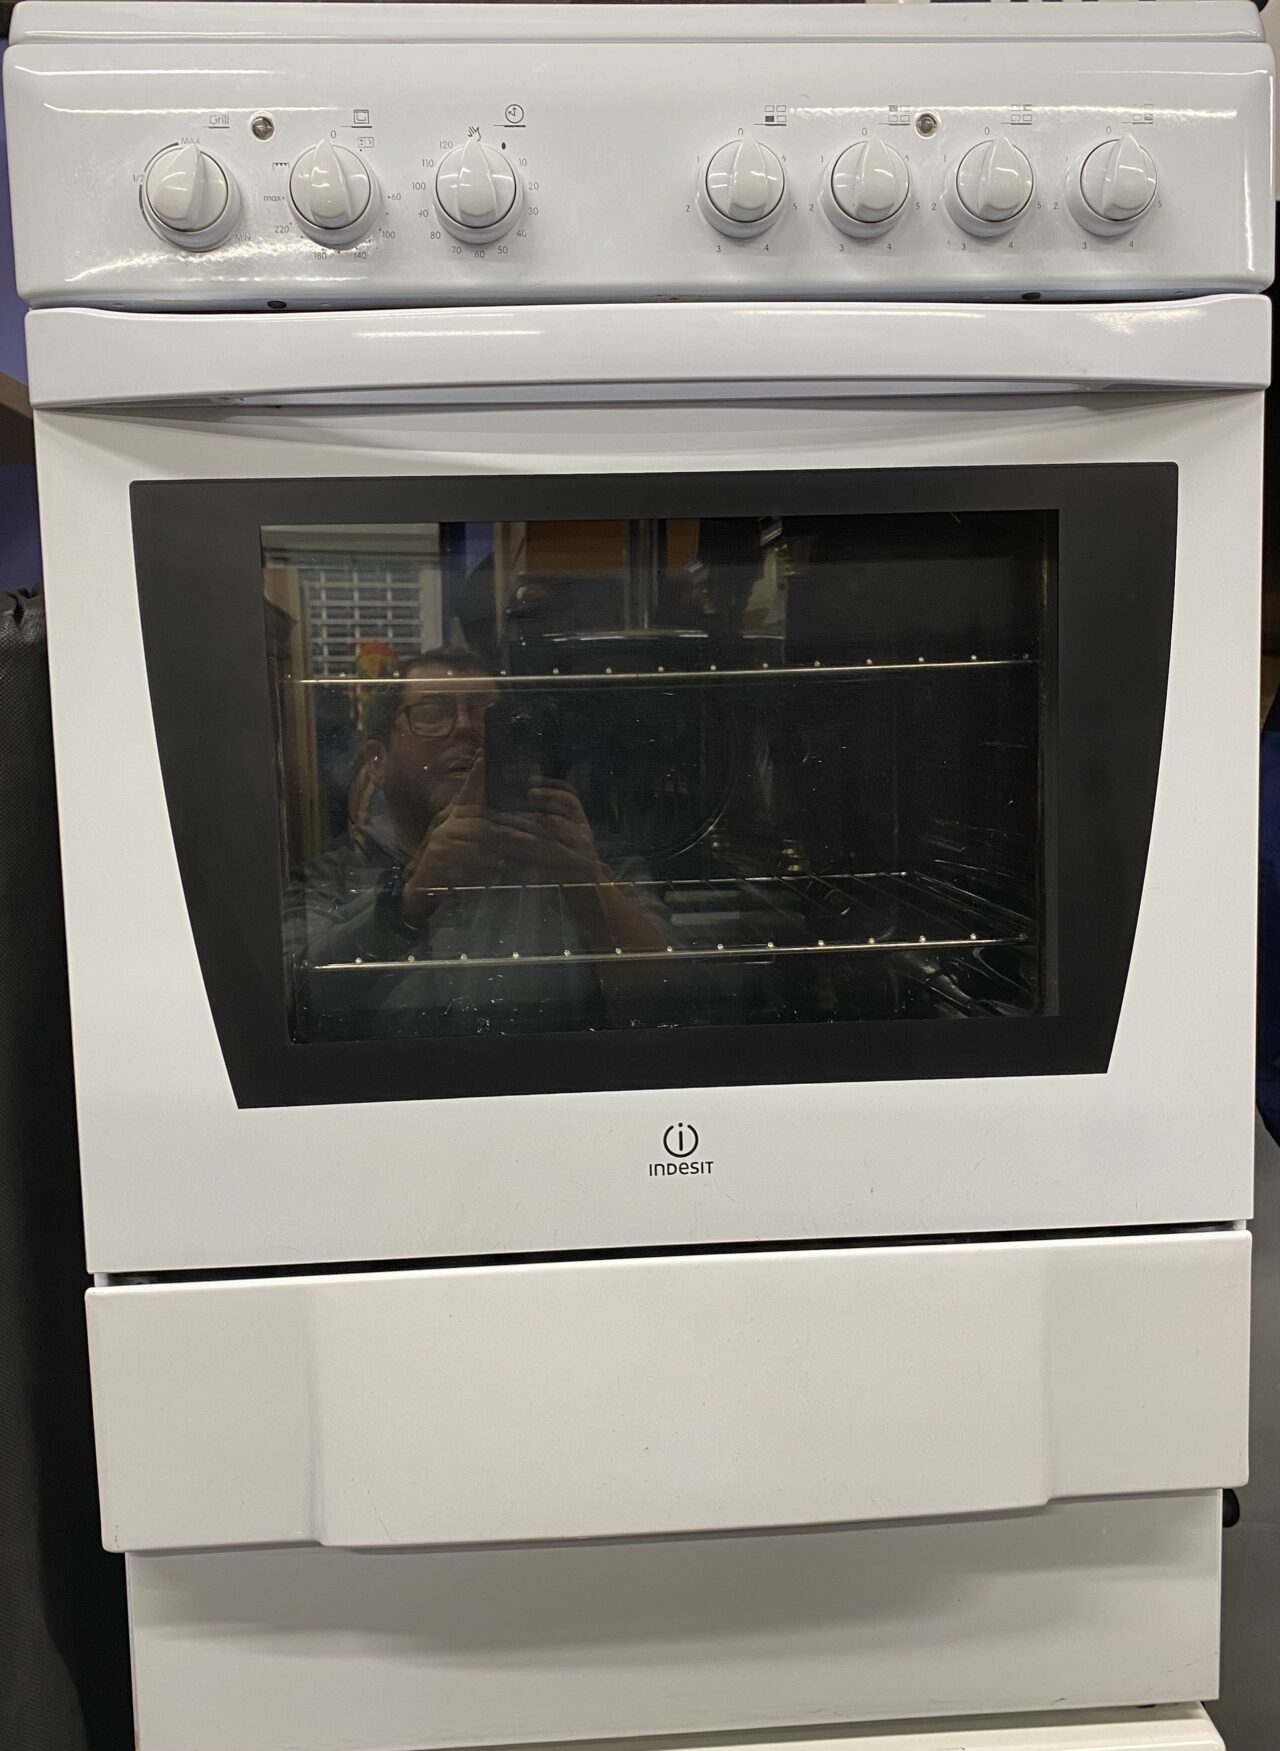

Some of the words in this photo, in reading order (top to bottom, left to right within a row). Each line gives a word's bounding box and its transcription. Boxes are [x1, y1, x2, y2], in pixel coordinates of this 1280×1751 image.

[209, 114, 230, 125] Grill
[331, 130, 337, 139] 0
[862, 128, 868, 136] 0
[984, 127, 990, 136] 0
[1106, 126, 1112, 135] 0
[440, 141, 453, 149] 120
[422, 159, 434, 168] 110
[518, 158, 528, 167] 10
[133, 174, 144, 182] 1/2
[412, 182, 426, 190] 100
[529, 182, 539, 190] 20
[392, 193, 402, 201] 60
[686, 205, 691, 213] 2
[793, 203, 798, 211] 5
[809, 204, 814, 212] 2
[932, 203, 937, 211] 2
[1053, 202, 1058, 210] 2
[418, 209, 429, 218] 90
[528, 207, 539, 215] 30
[275, 226, 290, 234] 220
[517, 229, 527, 237] 40
[383, 231, 396, 239] 100
[430, 232, 441, 240] 80
[716, 245, 722, 253] 3
[840, 244, 845, 252] 3
[1008, 241, 1014, 249] 4
[452, 247, 462, 255] 70
[498, 246, 508, 254] 50
[314, 252, 327, 260] 180
[354, 252, 367, 260] 140
[475, 250, 486, 259] 60
